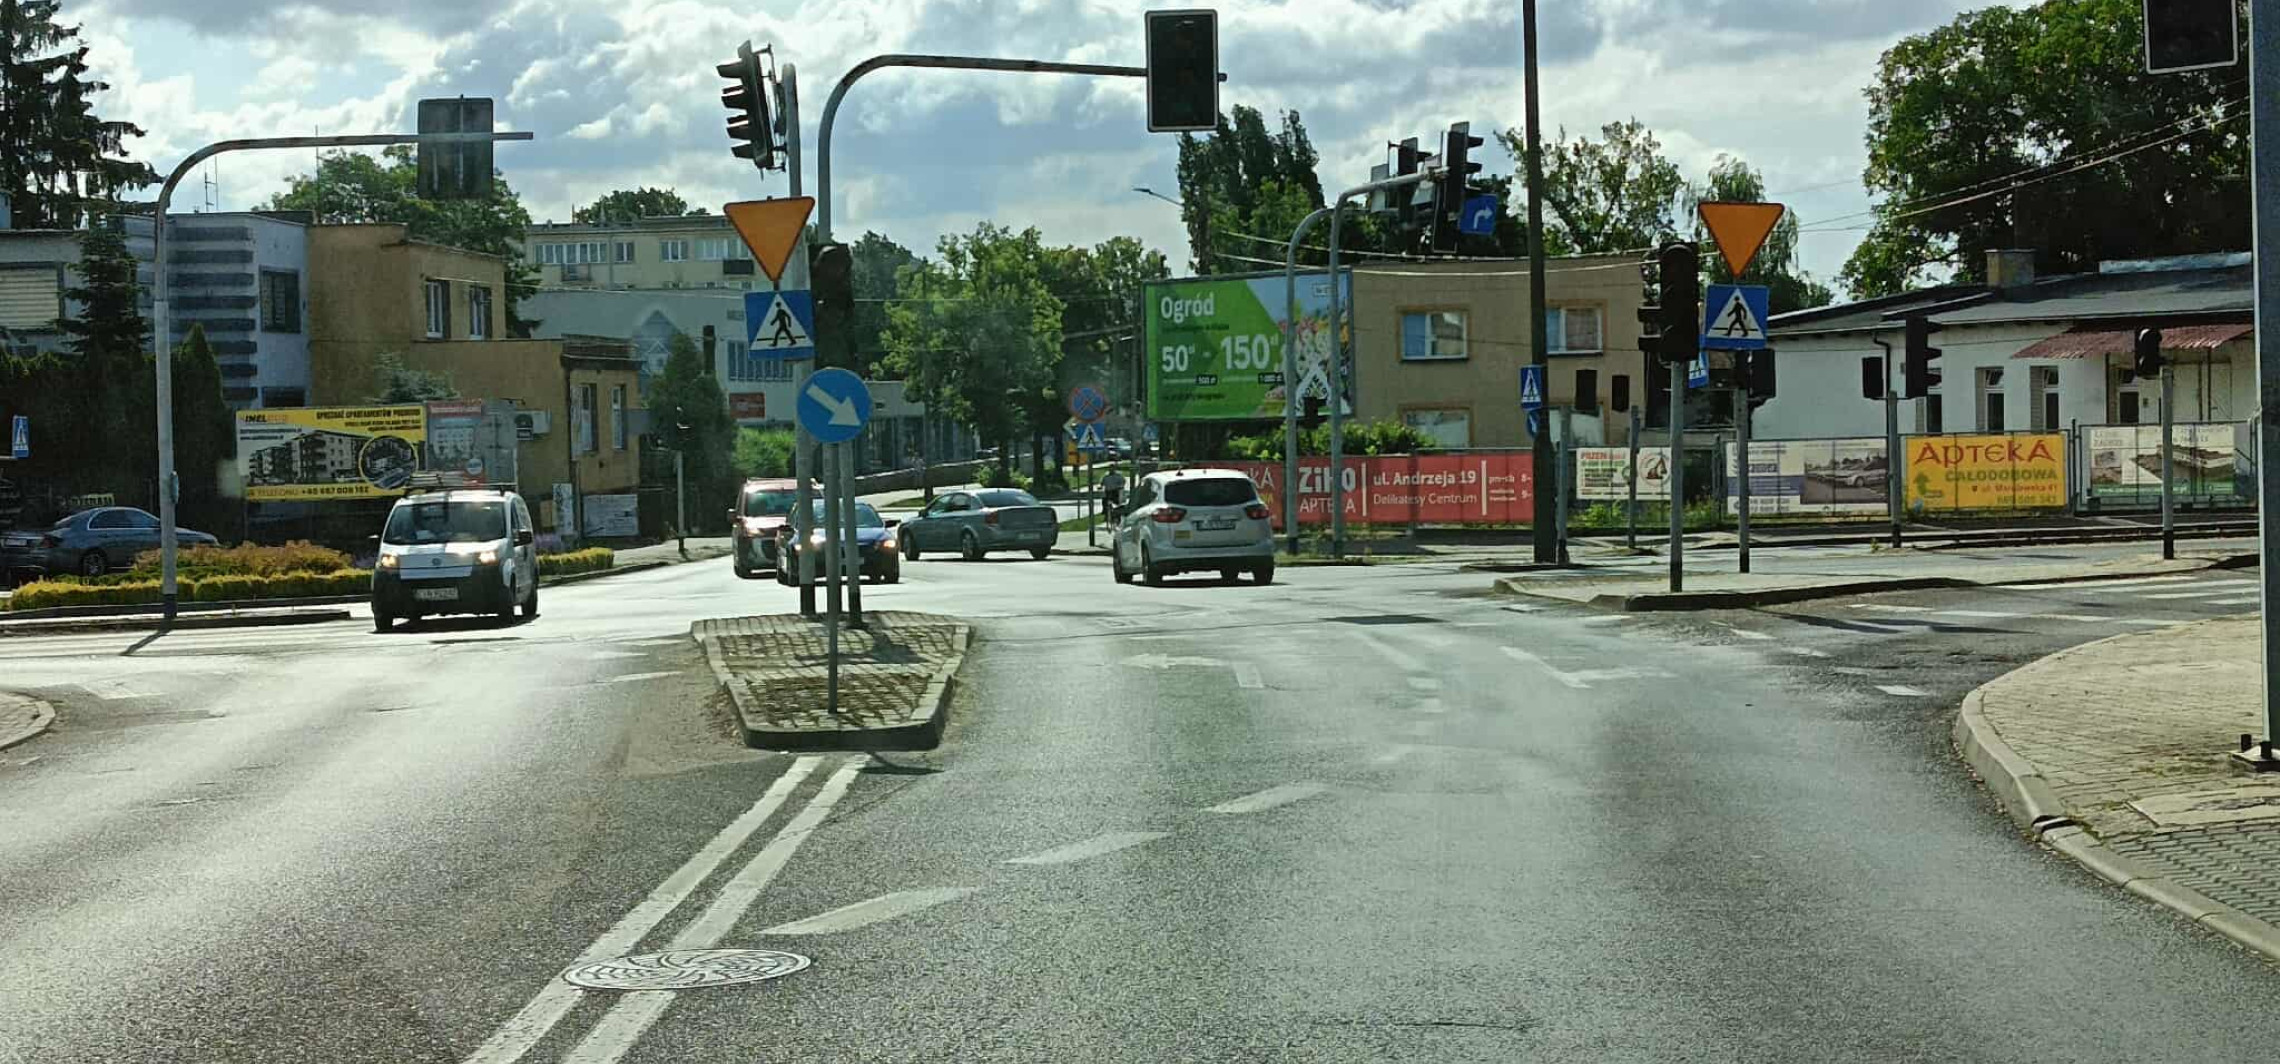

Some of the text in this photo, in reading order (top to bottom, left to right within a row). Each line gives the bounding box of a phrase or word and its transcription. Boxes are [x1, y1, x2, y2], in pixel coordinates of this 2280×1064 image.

[1160, 290, 1215, 324] Ogród
[1392, 470, 1456, 488] Andrzeja
[1459, 469, 1477, 484] 19
[1299, 496, 1356, 513] APTEA
[1427, 492, 1478, 505] Centrum
